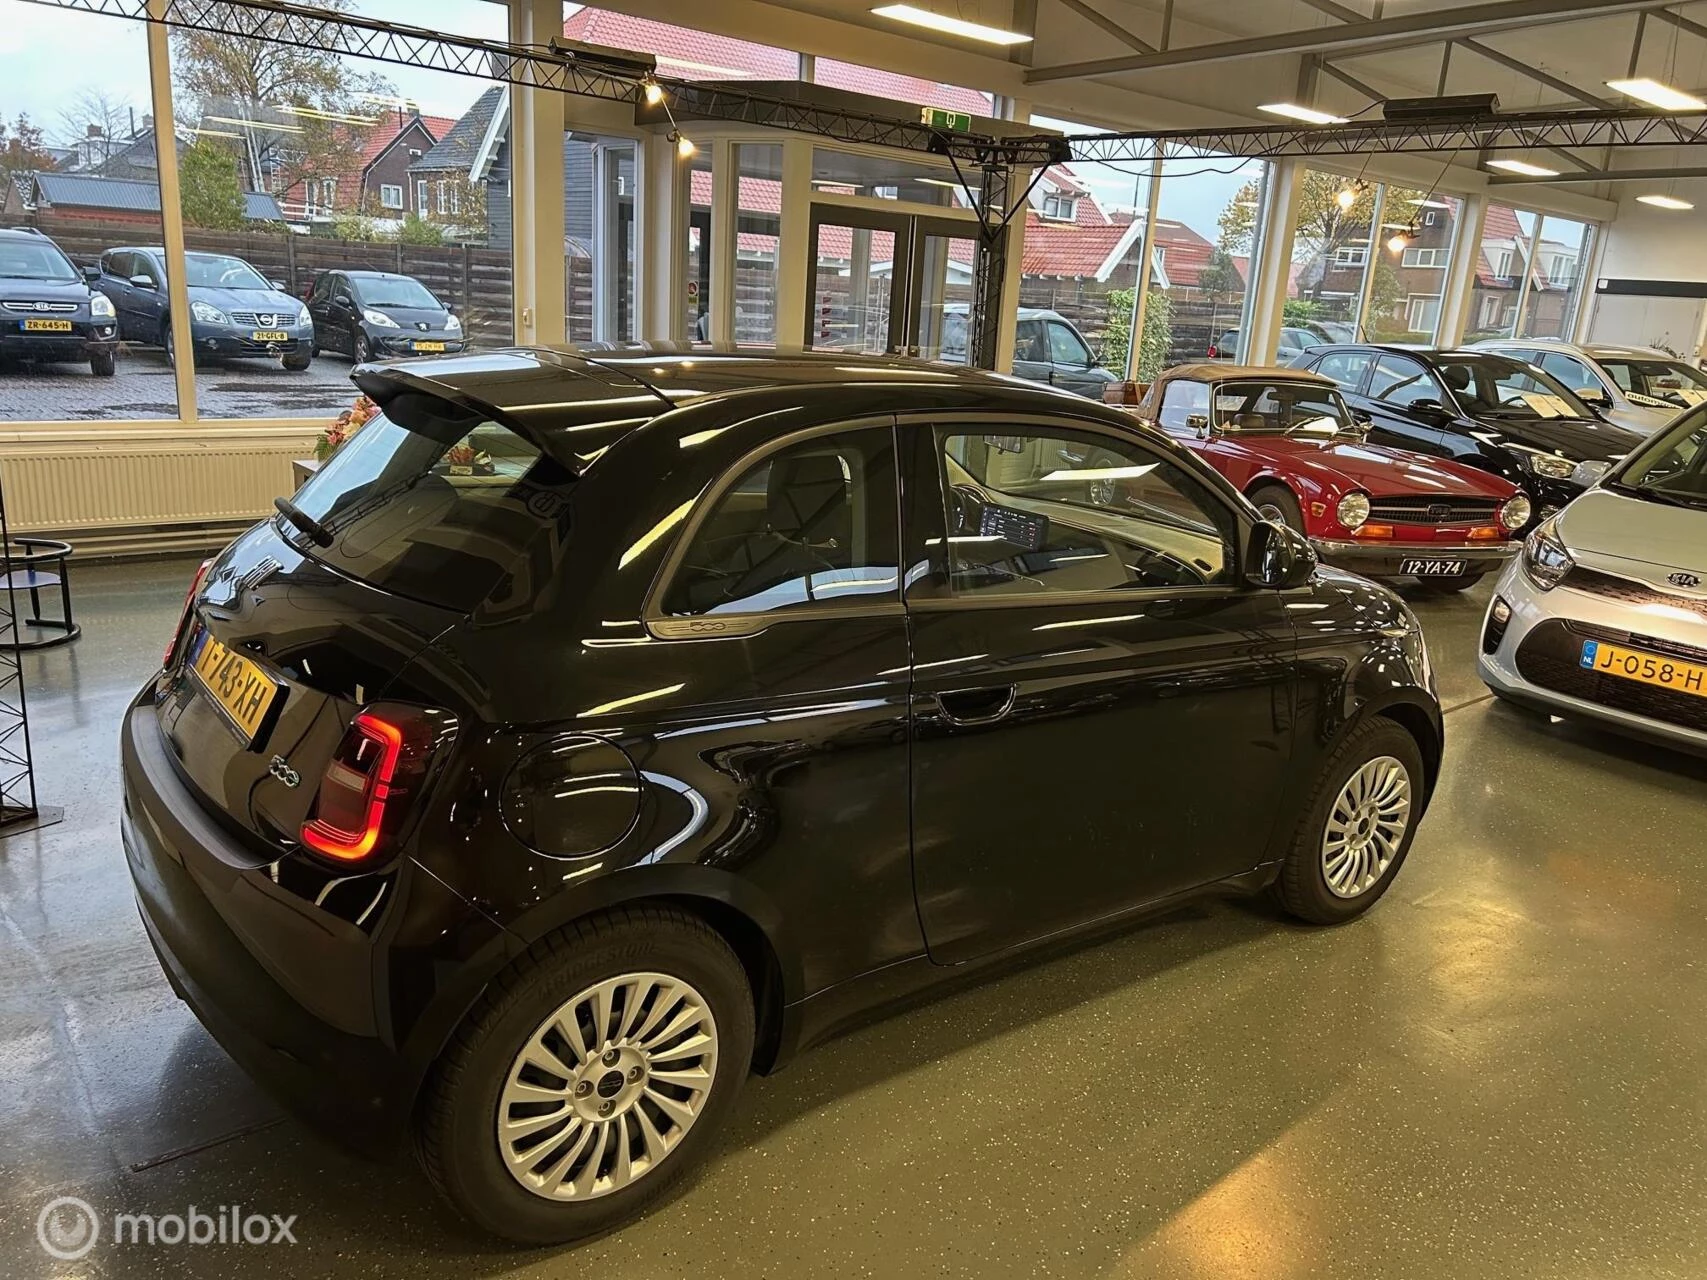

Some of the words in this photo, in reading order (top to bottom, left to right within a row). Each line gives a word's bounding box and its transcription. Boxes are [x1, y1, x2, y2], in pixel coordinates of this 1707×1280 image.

[27, 320, 69, 329] ZR-645-H
[1406, 560, 1462, 574] 12-YA-74
[1670, 573, 1697, 585] KIA
[1582, 655, 1594, 665] NL
